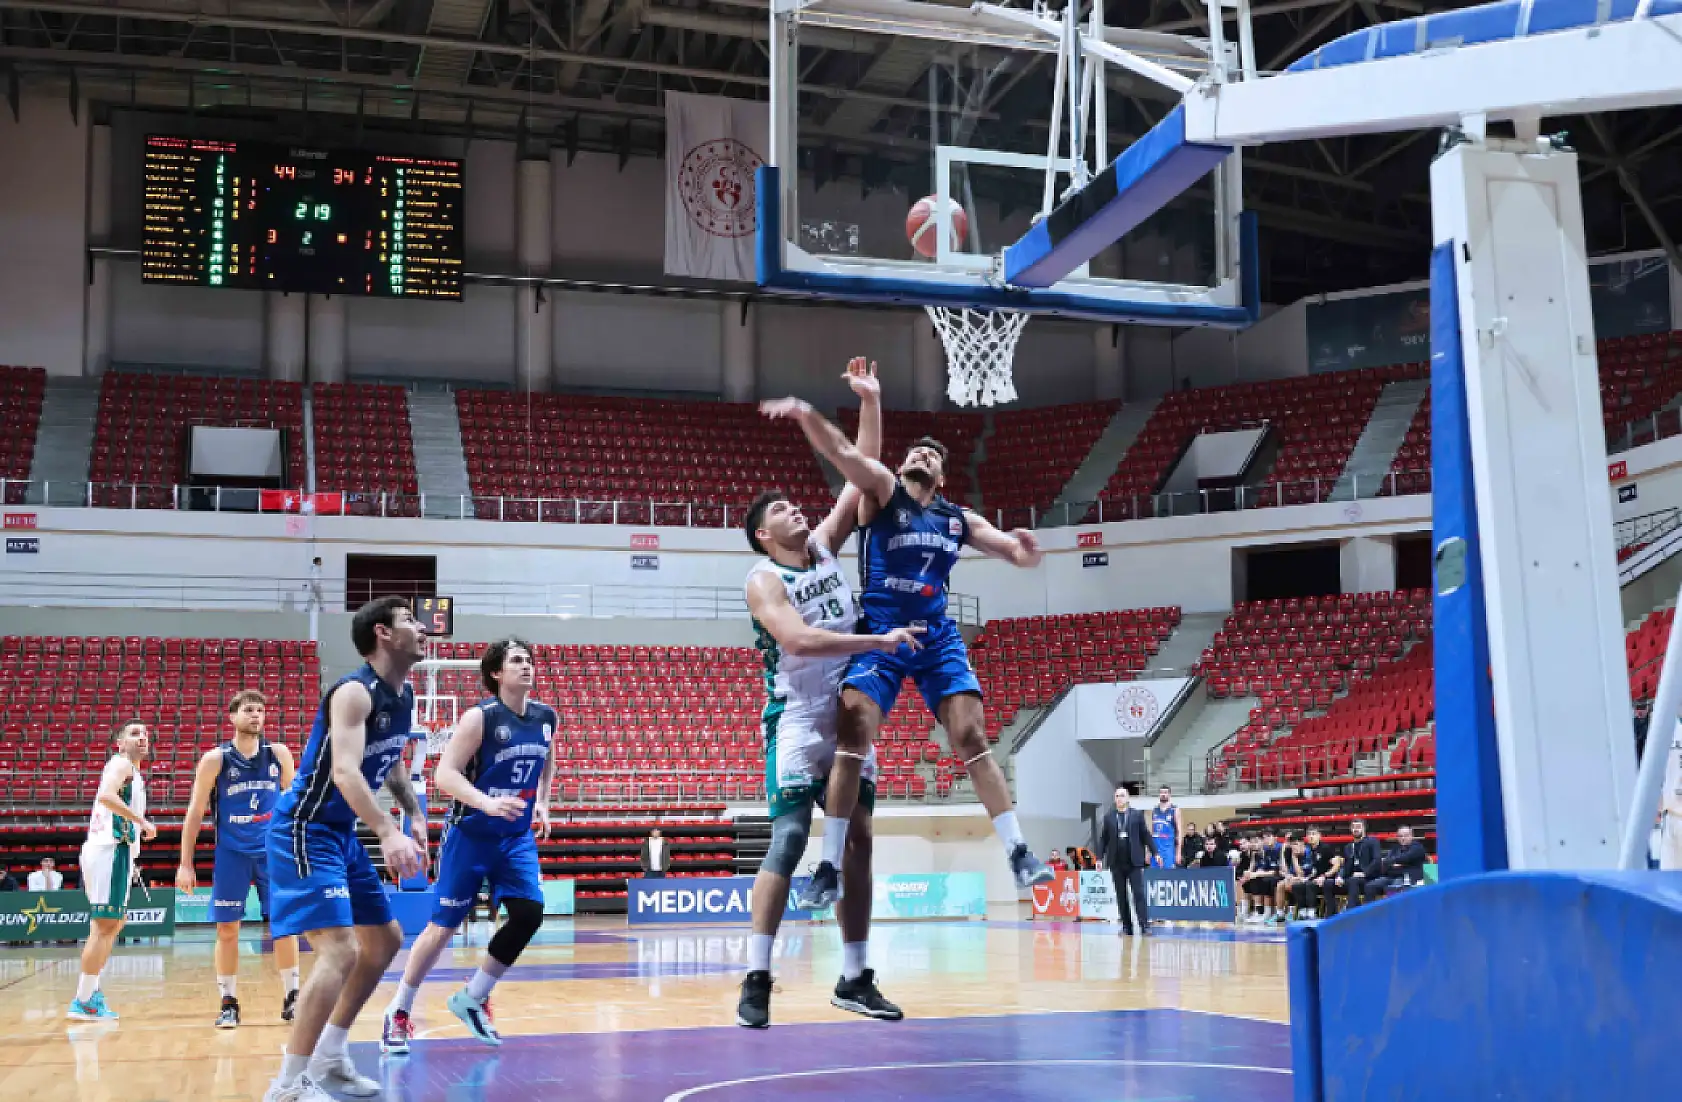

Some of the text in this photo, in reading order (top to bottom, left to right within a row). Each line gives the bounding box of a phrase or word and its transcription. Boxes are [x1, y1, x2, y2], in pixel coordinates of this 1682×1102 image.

[274, 164, 296, 180] 44
[333, 168, 355, 185] 34
[295, 203, 331, 221] 2 19
[267, 229, 277, 243] 3
[918, 551, 936, 577] 7
[432, 612, 445, 633] 5
[508, 758, 535, 785] 57
[249, 792, 259, 811] 4
[636, 889, 752, 914] MEDICA
[35, 912, 89, 924] YILDIZI
